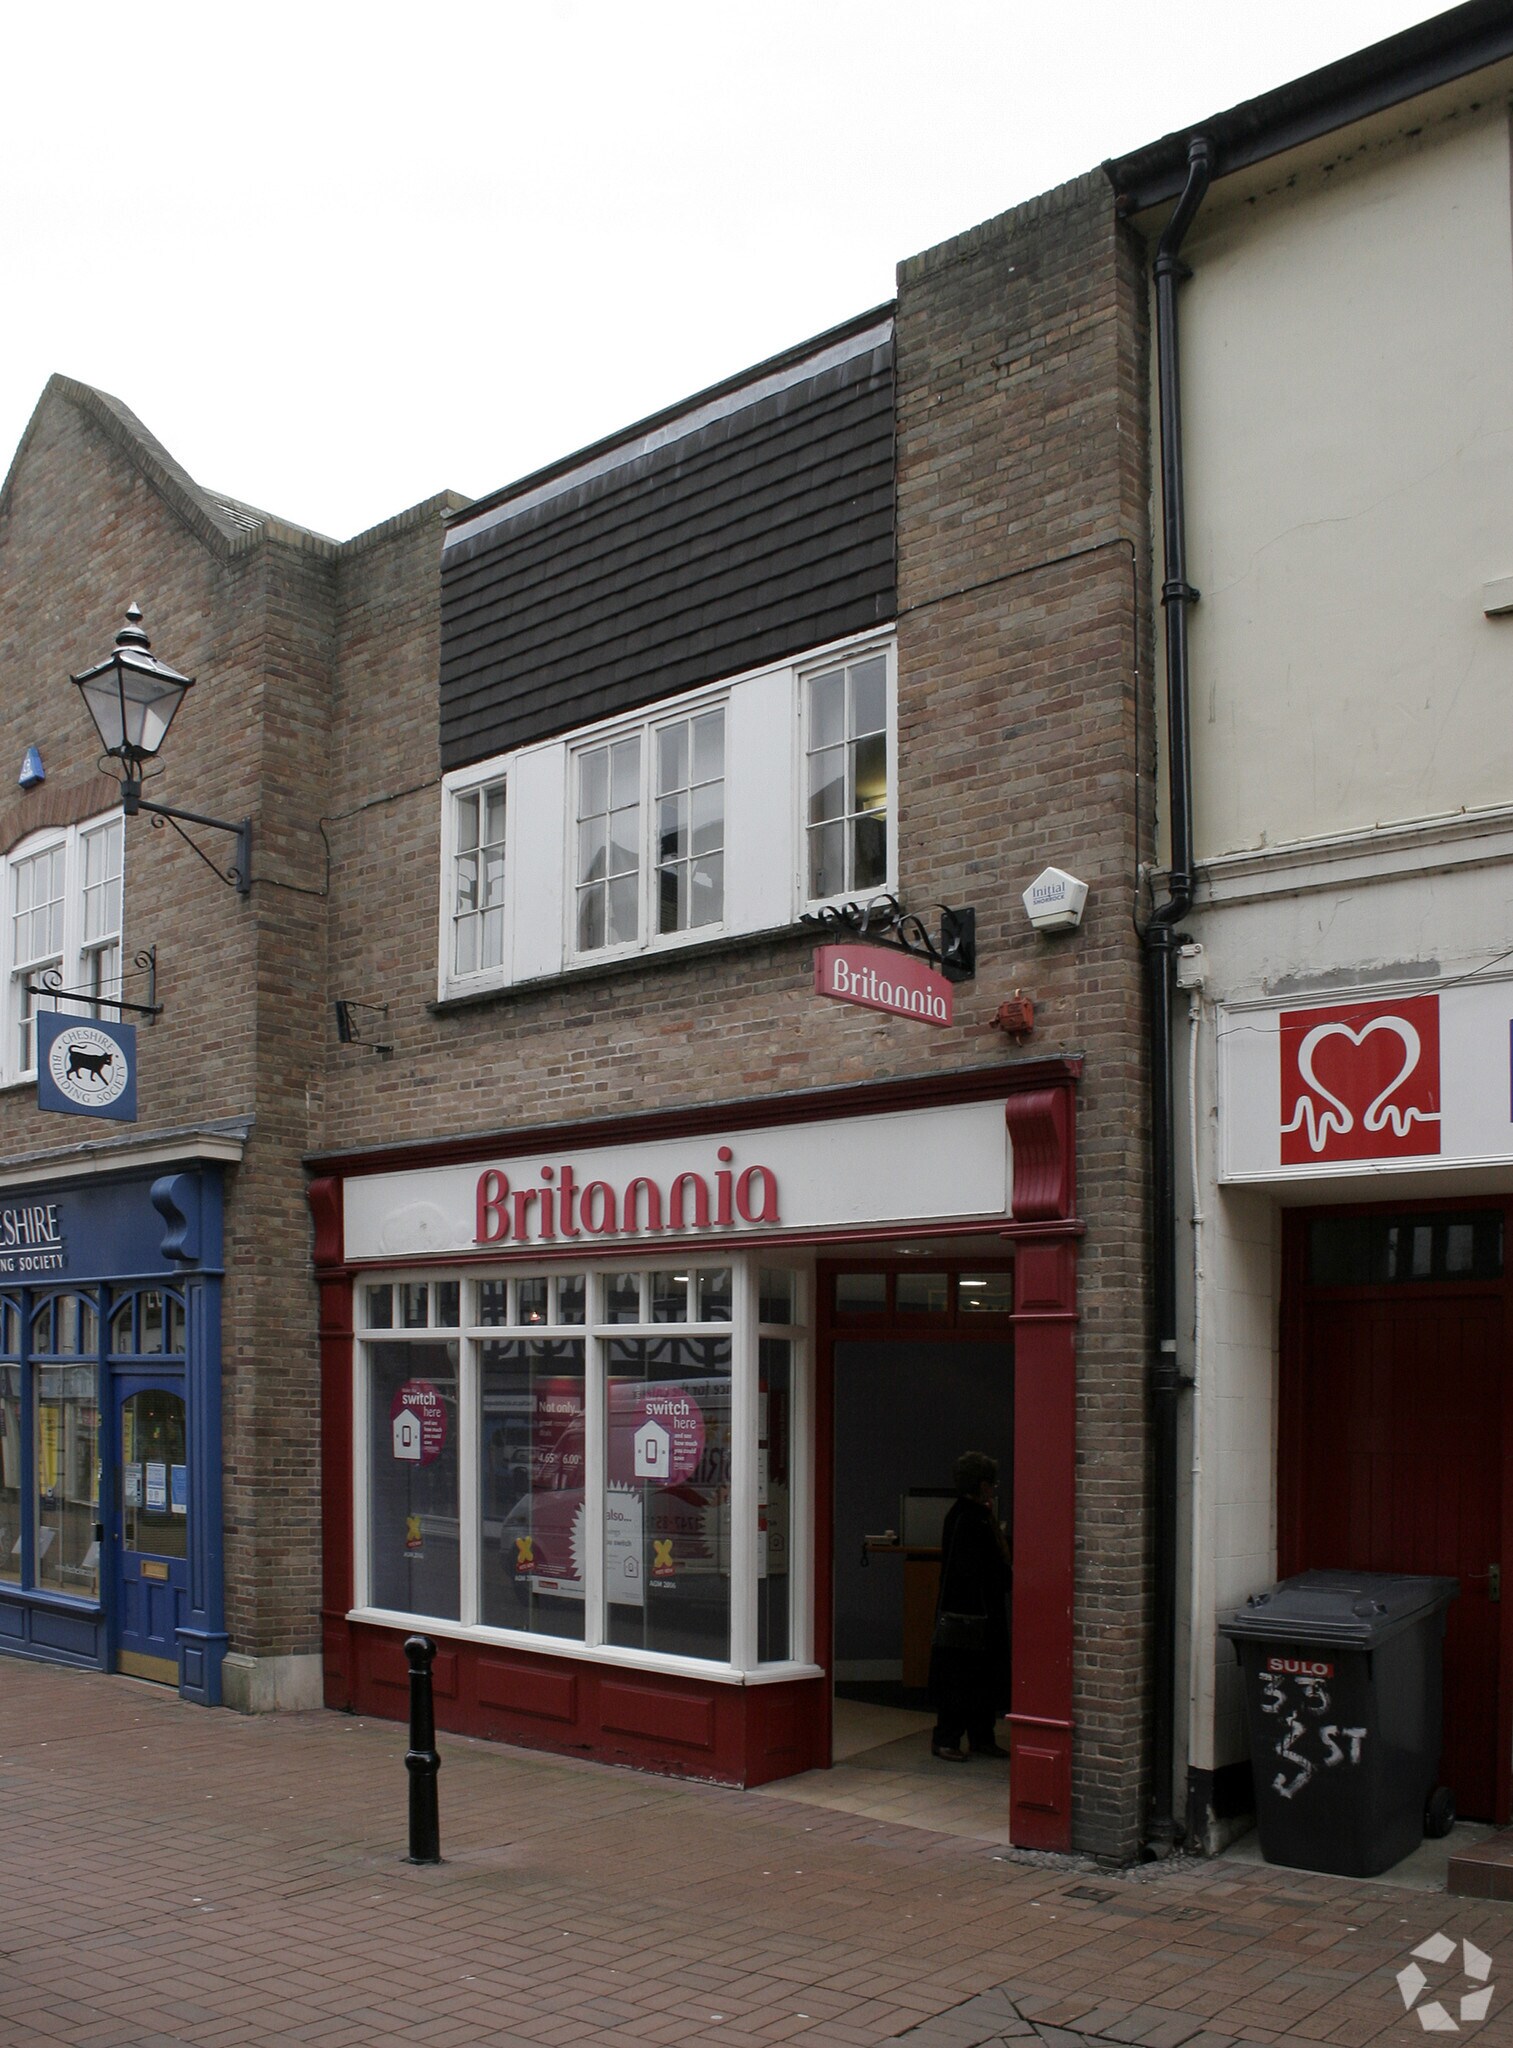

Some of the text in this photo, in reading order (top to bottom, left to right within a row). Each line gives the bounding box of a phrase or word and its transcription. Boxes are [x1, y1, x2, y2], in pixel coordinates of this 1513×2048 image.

[1032, 882, 1065, 898] Initial
[831, 958, 948, 1021] Britannia
[62, 1030, 115, 1052] CHESHIRE
[52, 1055, 126, 1104] BUILDING SOCIETY
[471, 1145, 782, 1244] Britannia
[18, 1253, 64, 1272] SOCIETY
[401, 1391, 437, 1406] switch
[538, 1401, 555, 1413] Not
[645, 1398, 691, 1416] switch
[423, 1406, 442, 1418] here
[673, 1416, 697, 1430] here
[1269, 1657, 1329, 1676] SULO
